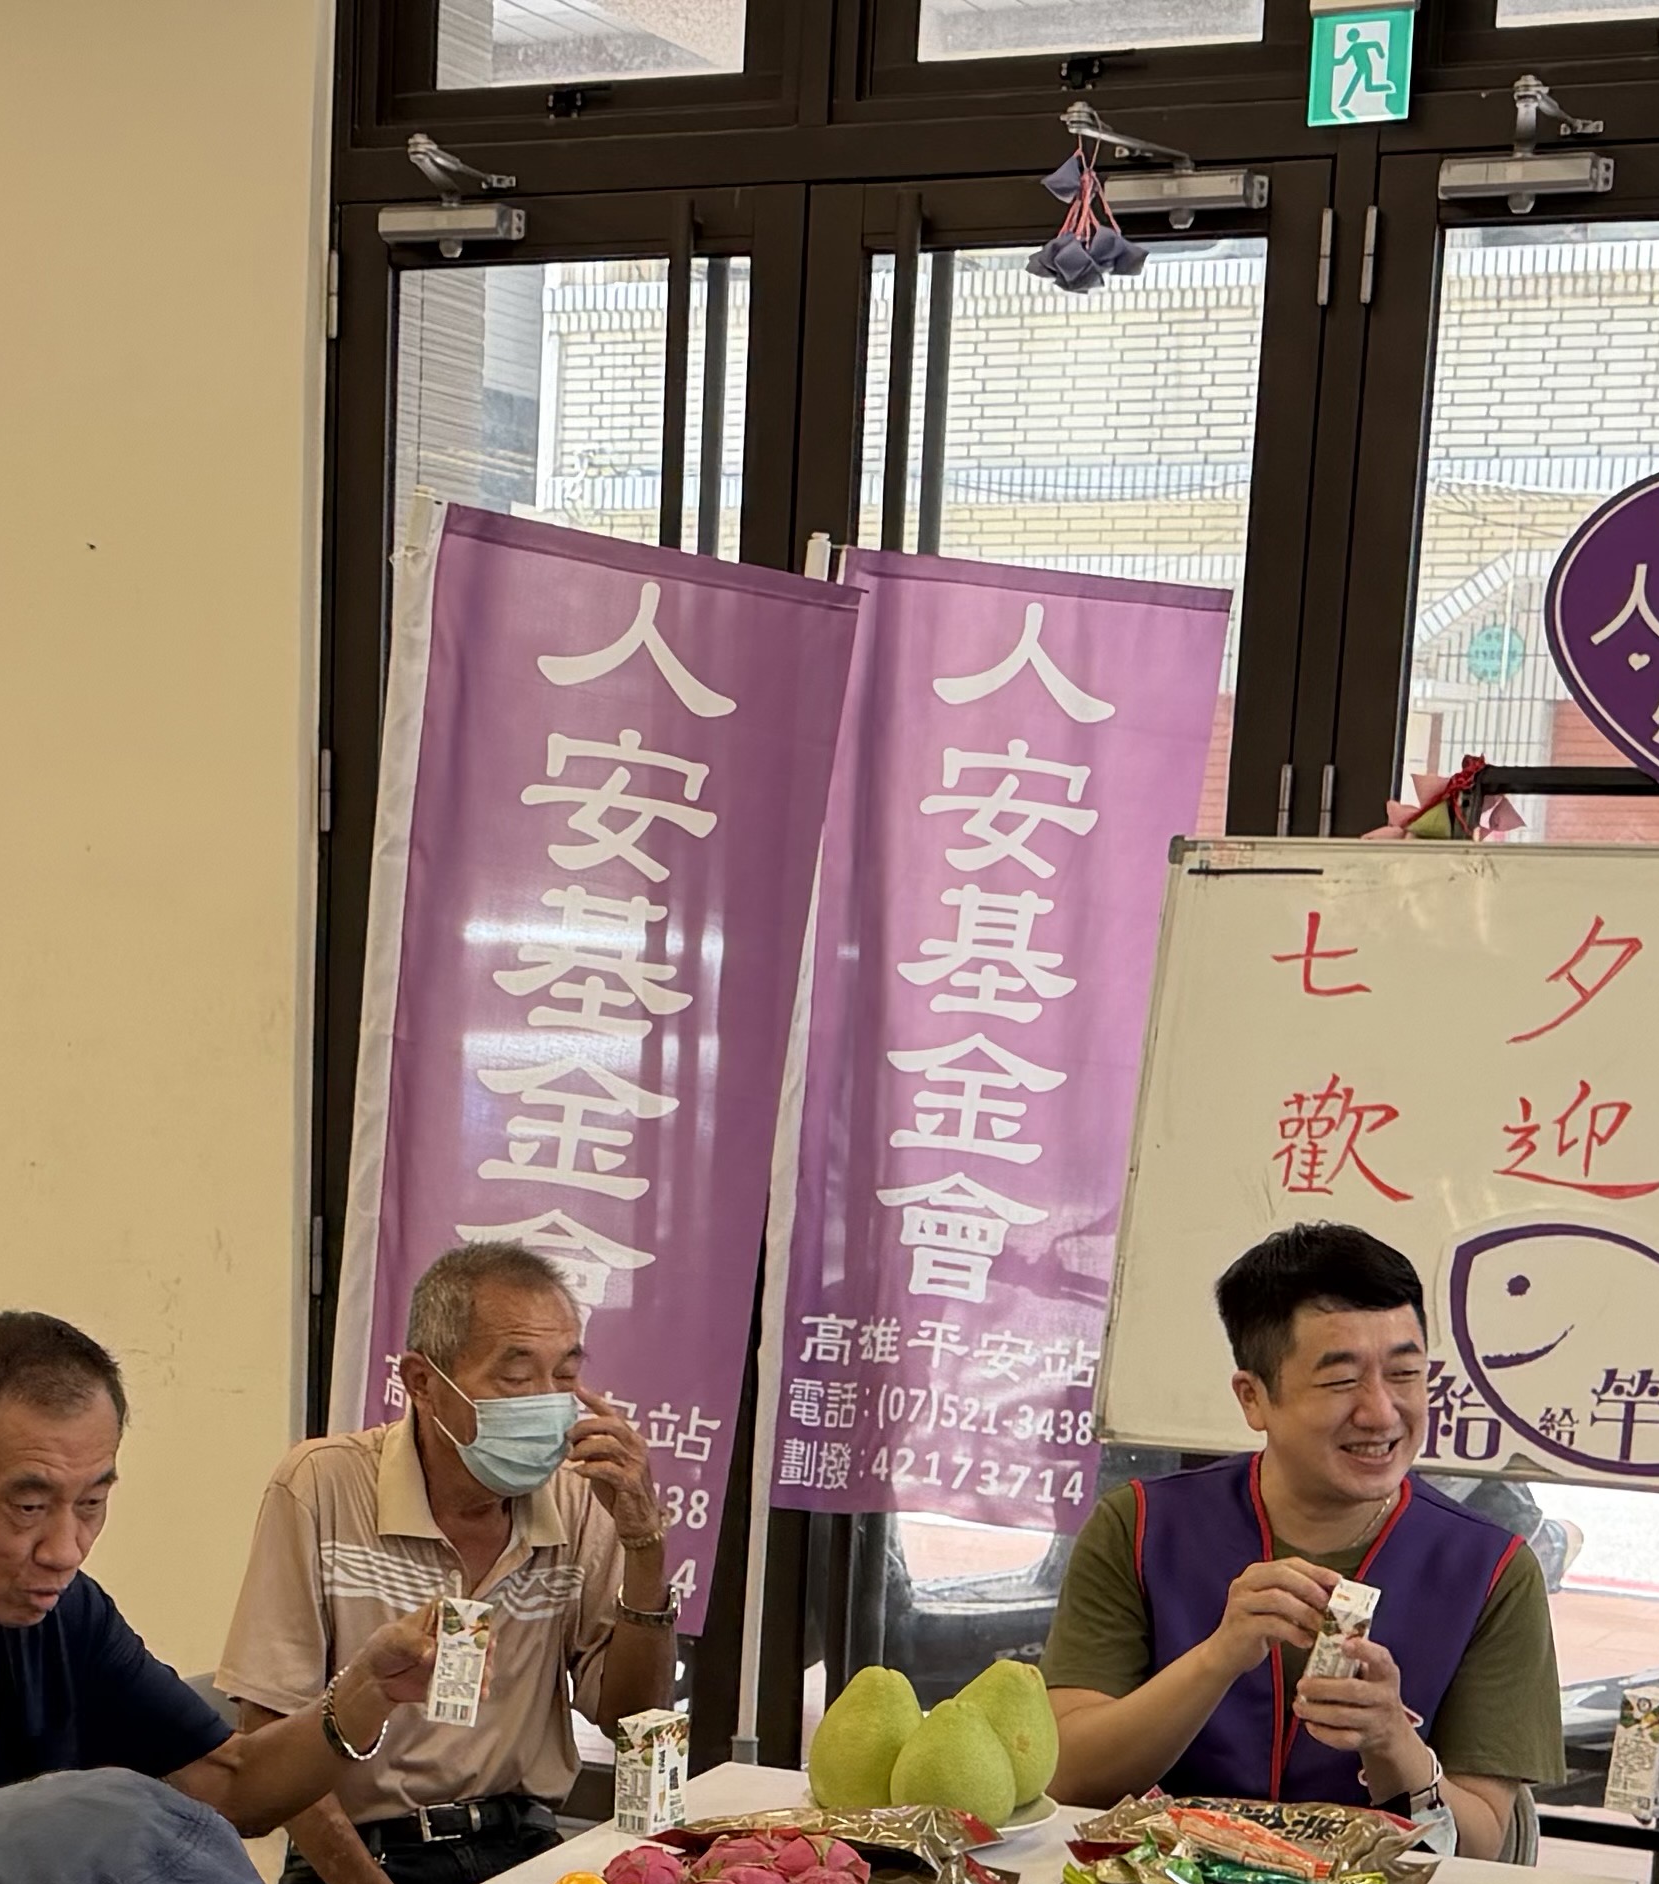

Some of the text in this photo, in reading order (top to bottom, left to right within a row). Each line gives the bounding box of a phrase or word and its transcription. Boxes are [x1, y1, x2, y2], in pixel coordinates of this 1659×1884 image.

[874, 602, 1116, 1304] 人安基金會
[799, 1312, 1100, 1388] 高雄平安站
